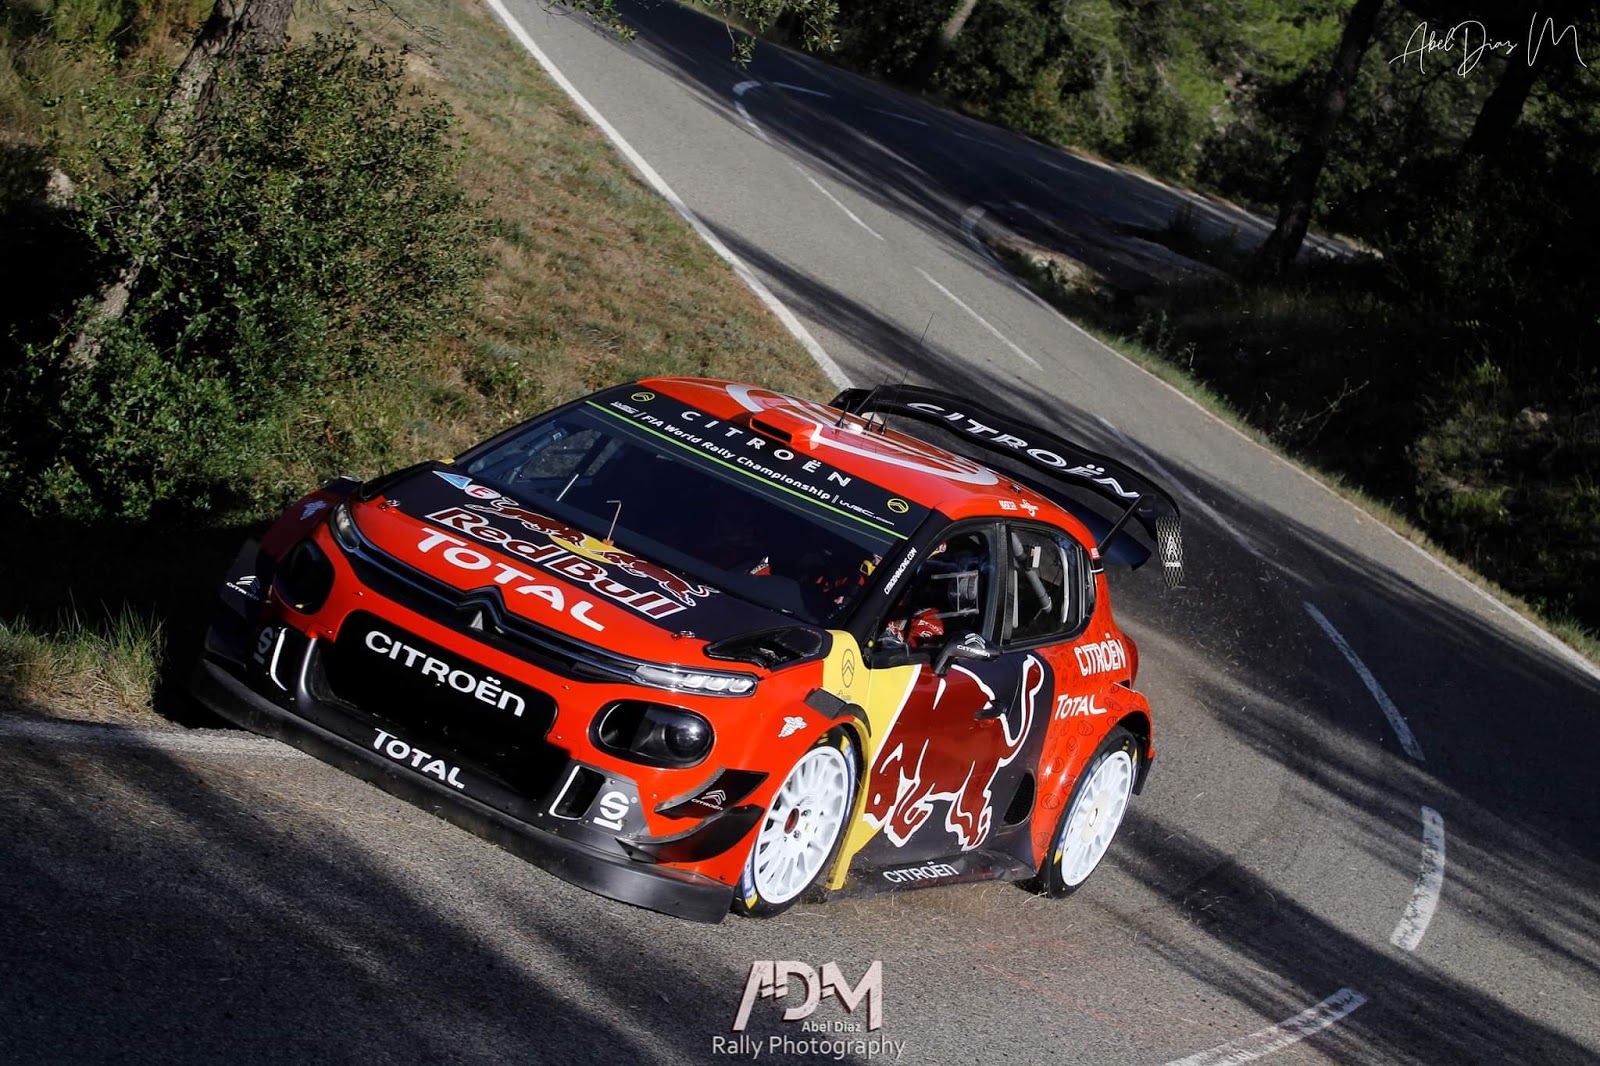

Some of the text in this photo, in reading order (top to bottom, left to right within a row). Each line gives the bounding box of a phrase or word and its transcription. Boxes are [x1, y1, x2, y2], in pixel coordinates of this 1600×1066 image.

[642, 415, 665, 427] FIA
[664, 424, 703, 443] World
[701, 441, 737, 459] Rally
[737, 456, 831, 500] Championship
[681, 410, 852, 487] CITROËN
[906, 401, 1141, 498] CITROËN
[417, 527, 605, 632] TOTAL
[364, 631, 526, 717] CITROËN
[1073, 633, 1126, 677] CITROËN
[1054, 693, 1107, 720] TOTAL
[372, 728, 465, 789] TOTAL
[882, 861, 959, 883] CITROËN
